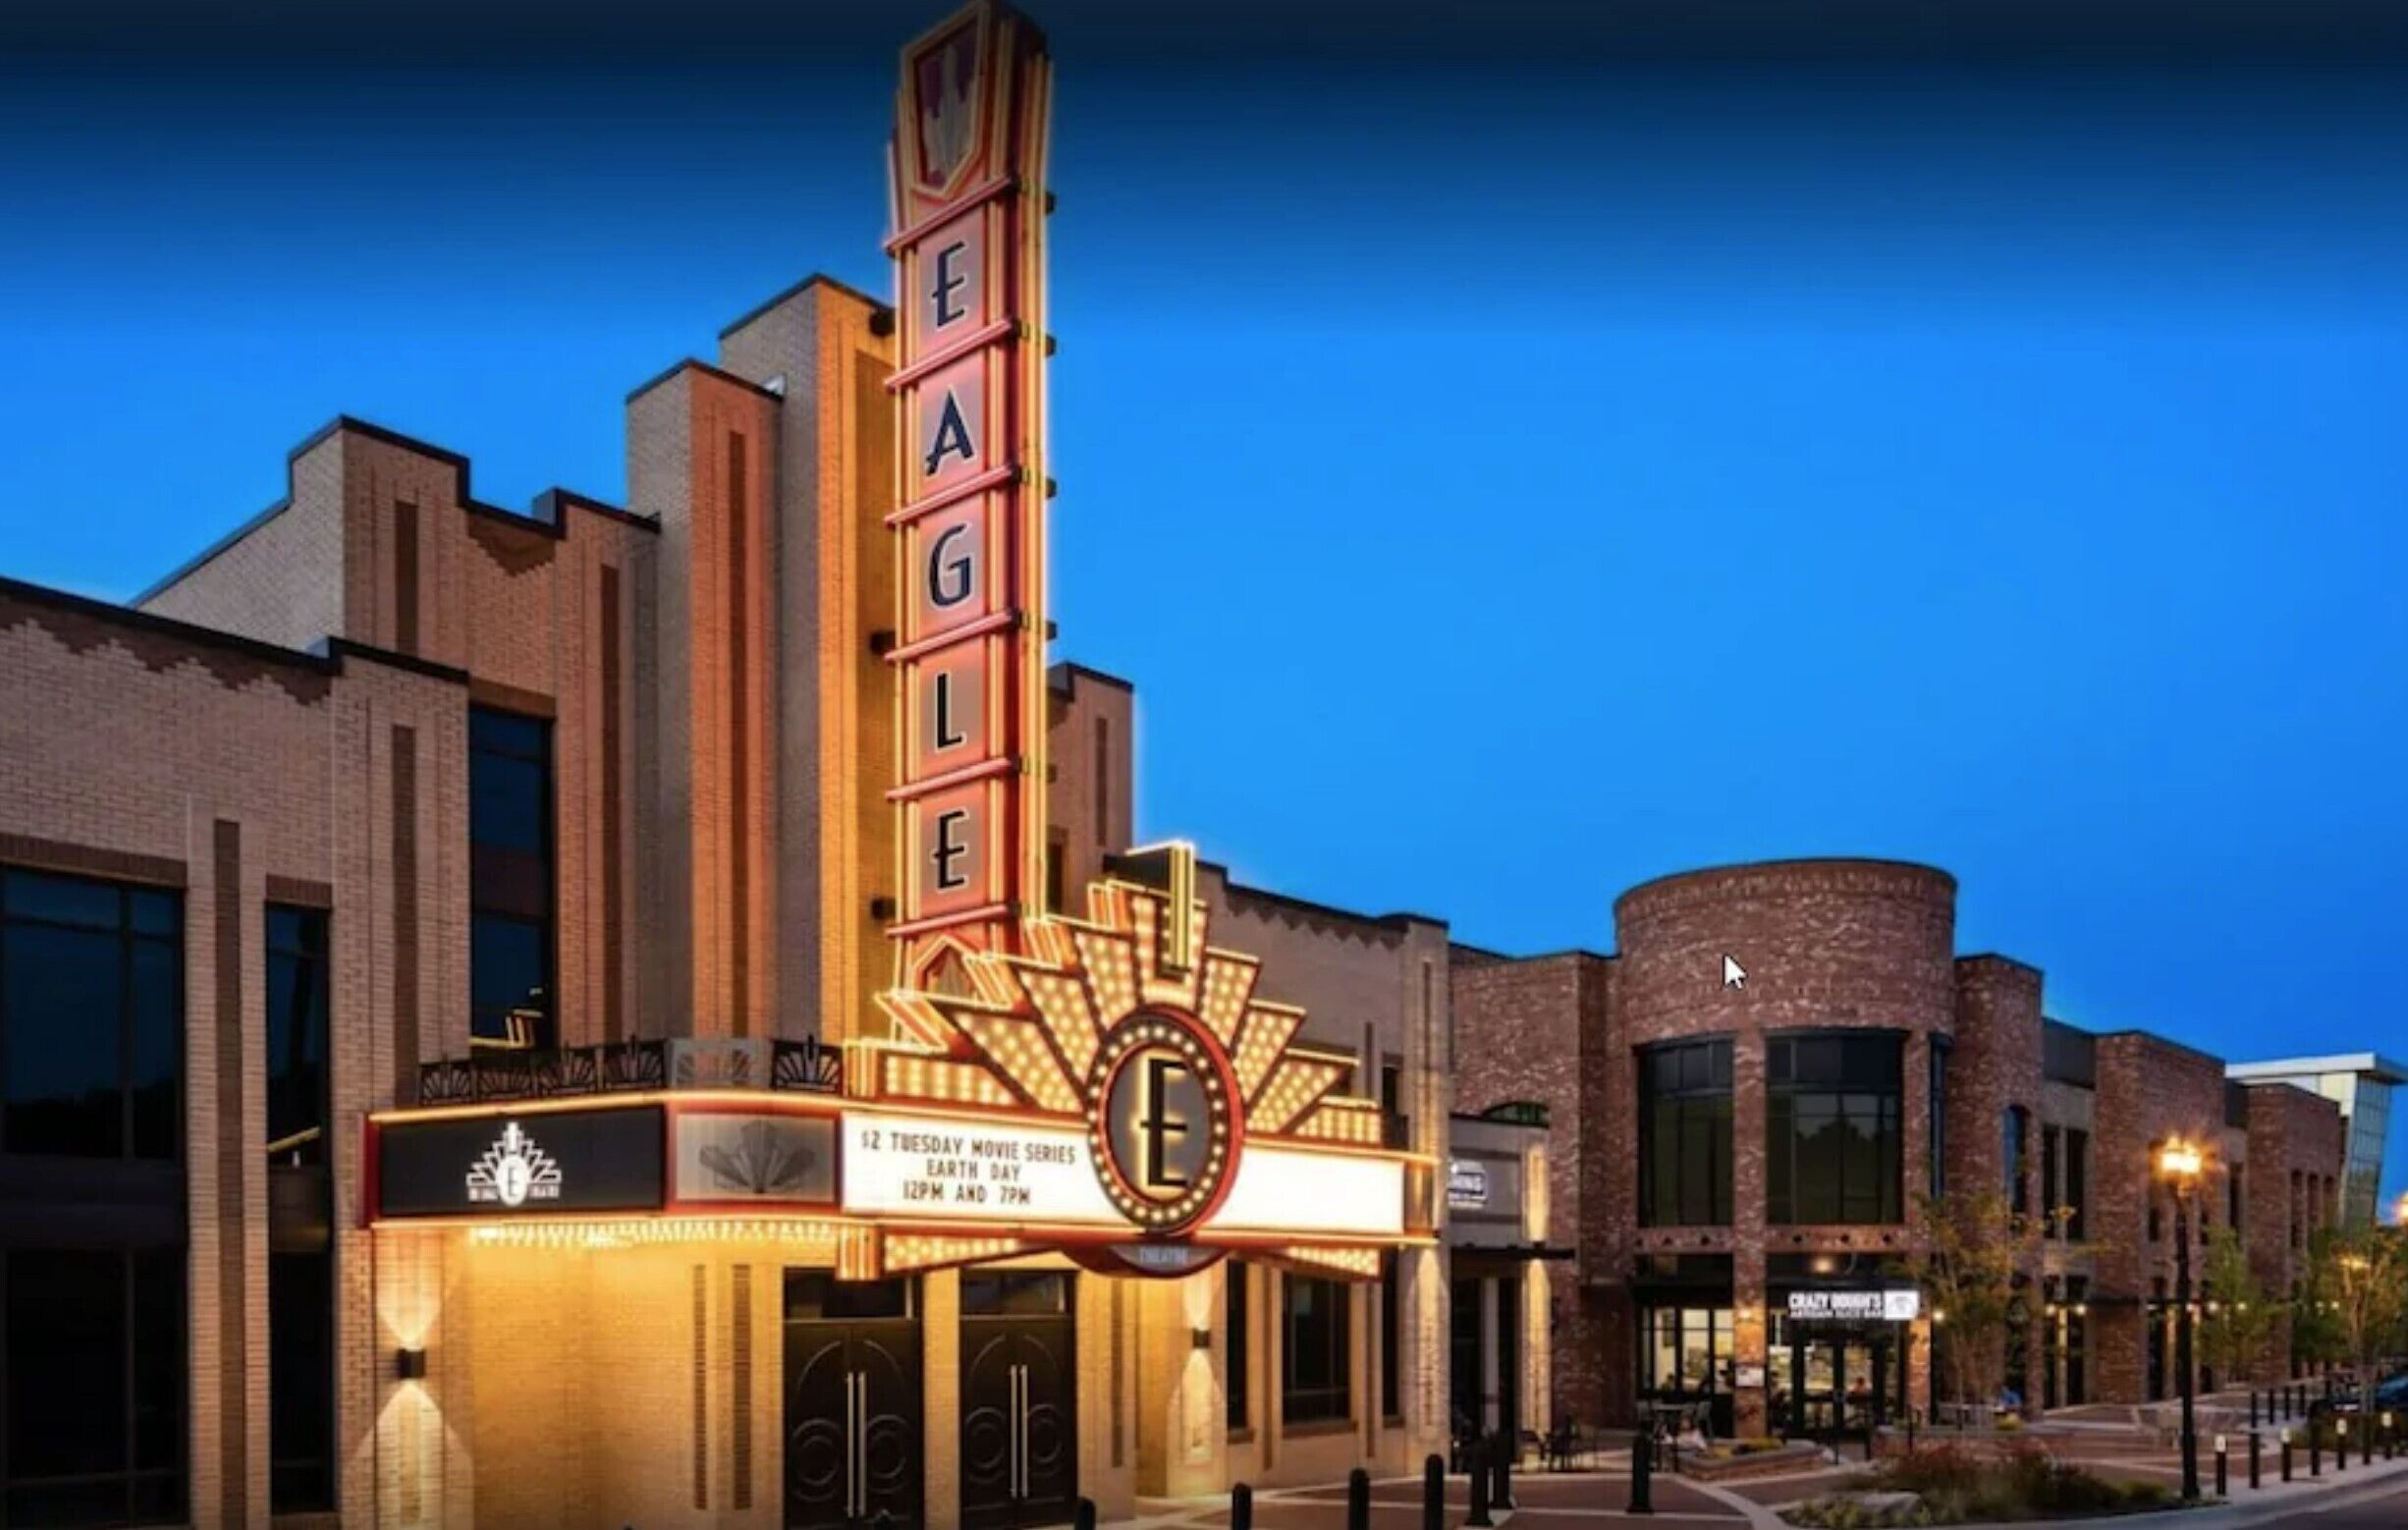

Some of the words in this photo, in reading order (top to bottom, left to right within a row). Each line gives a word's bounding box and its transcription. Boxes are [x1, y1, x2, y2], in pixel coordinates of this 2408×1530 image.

[925, 241, 975, 893] EAGLE
[1139, 1058, 1188, 1188] E
[890, 1132, 963, 1155] TUESDAY
[971, 1139, 1019, 1160] MOVIE
[1024, 1143, 1076, 1165] SERIES
[926, 1159, 978, 1178] EARTH
[990, 1163, 1022, 1182] DAY
[903, 1179, 944, 1201] 12PM
[955, 1183, 987, 1203] AND
[999, 1186, 1031, 1205] 7PM
[1788, 1290, 1829, 1308] CRAZY
